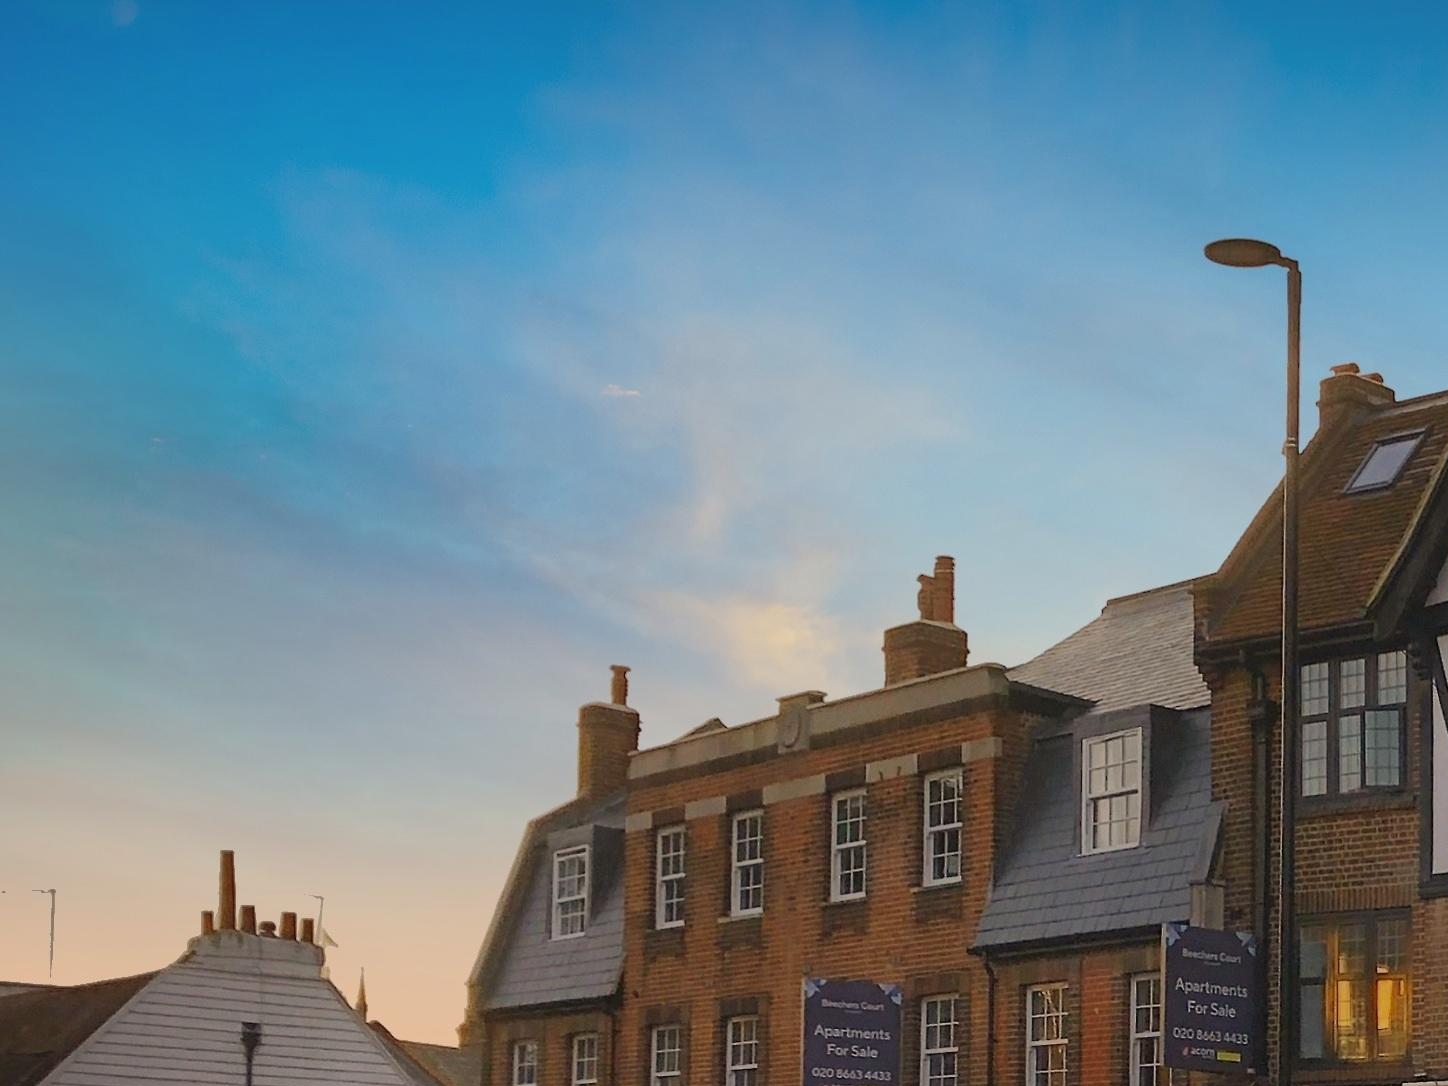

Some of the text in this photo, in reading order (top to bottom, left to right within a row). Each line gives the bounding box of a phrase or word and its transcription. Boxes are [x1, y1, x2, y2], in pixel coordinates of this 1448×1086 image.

[1175, 977, 1248, 998] Apartments
[1187, 1000, 1237, 1018] For Sale
[814, 1024, 891, 1040] Apartments
[1173, 1027, 1248, 1045] 020 8663 4433
[826, 1044, 879, 1058] For Sale
[812, 1067, 891, 1081] 020 8663 4433
